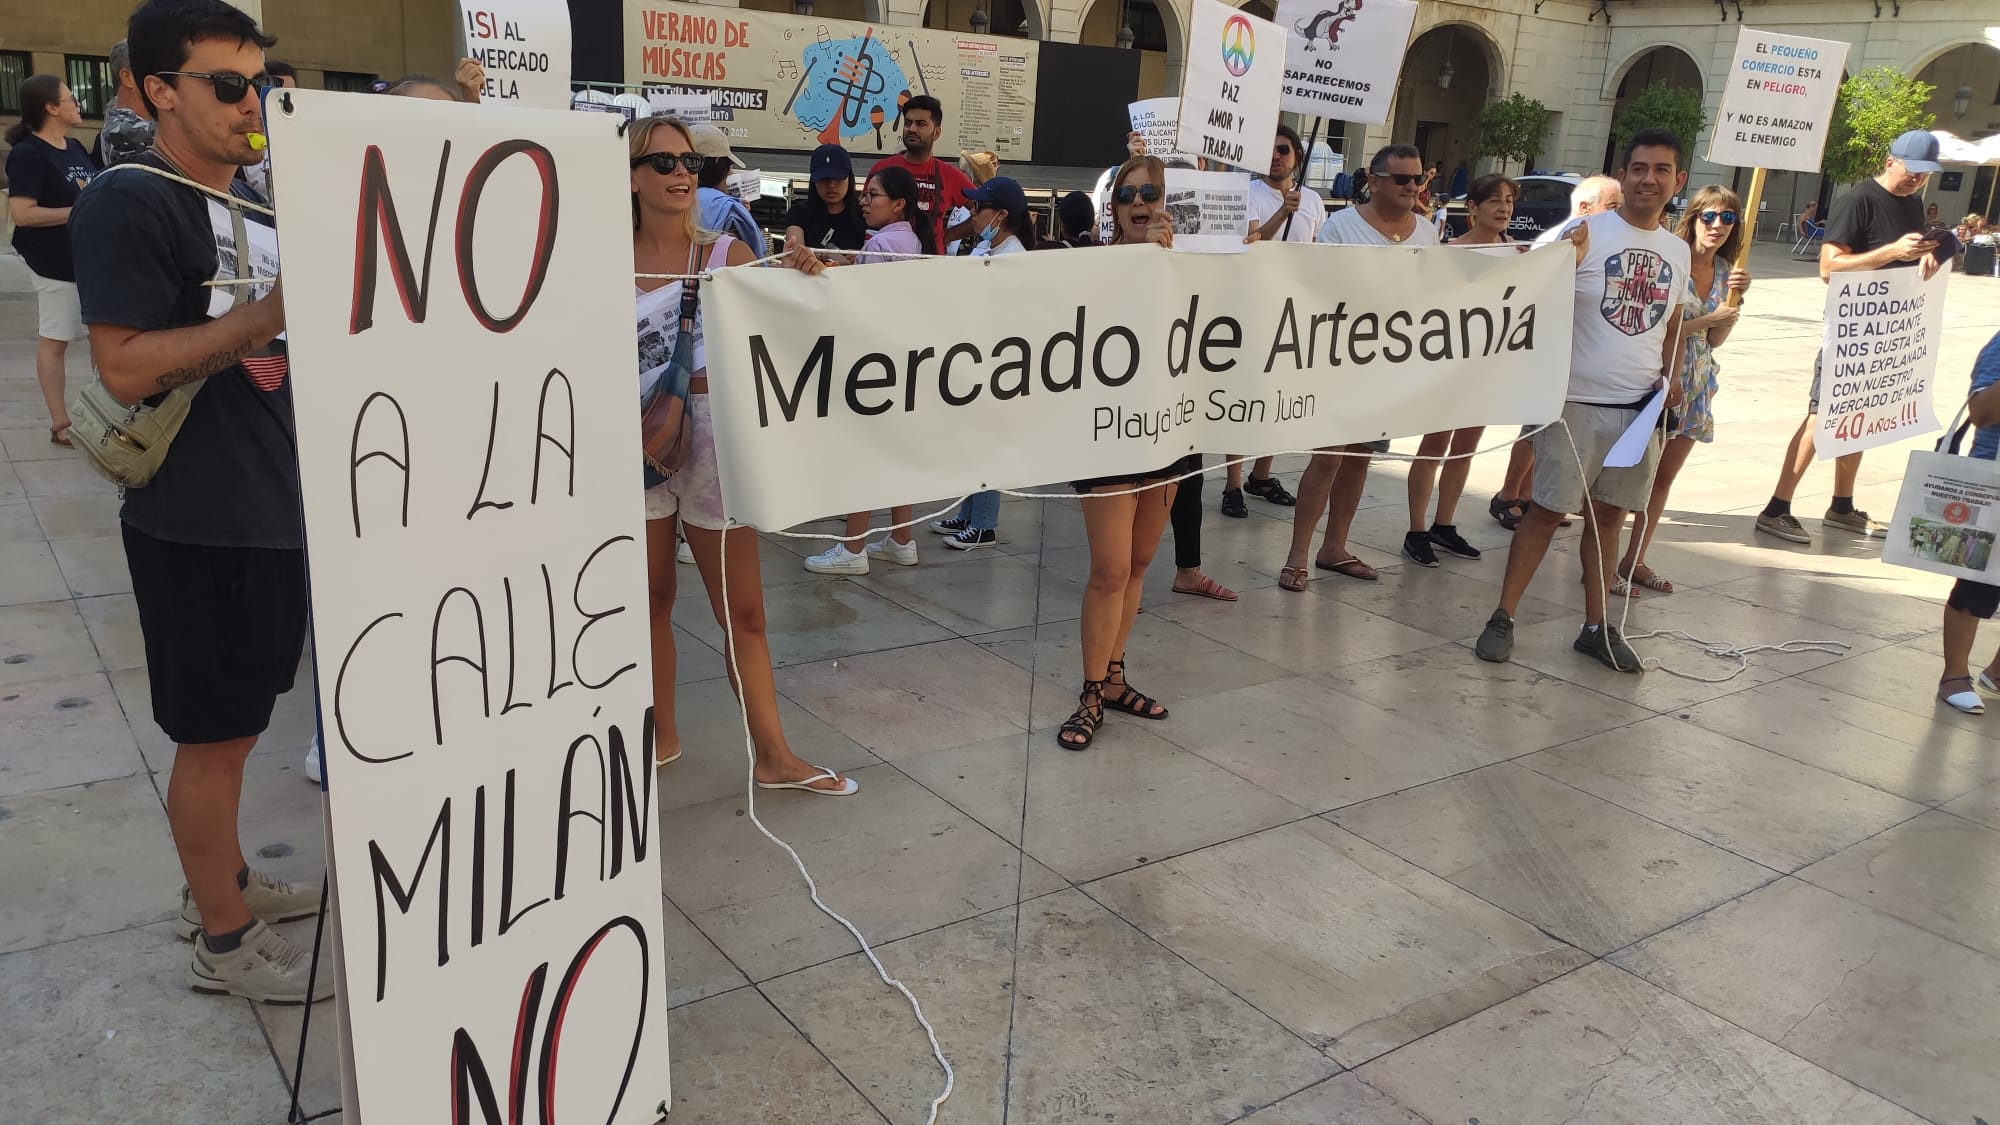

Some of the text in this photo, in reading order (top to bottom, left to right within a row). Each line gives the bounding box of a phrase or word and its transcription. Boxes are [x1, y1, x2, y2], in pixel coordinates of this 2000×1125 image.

[467, 10, 526, 41] !SI AL
[642, 10, 749, 48] VERANO DE
[472, 48, 549, 72] MERCADO
[642, 42, 726, 80] MÚSICAS
[1315, 58, 1333, 70] NO
[1756, 43, 1818, 60] EL PEQUEÑO
[1284, 69, 1371, 92] SAPARECEMOS
[1742, 60, 1822, 80] COMERCIO ESTA
[500, 79, 519, 99] LA
[1221, 81, 1240, 103] PAZ
[1296, 88, 1363, 107] EXTINGUEN
[1747, 79, 1808, 98] EN PELIGRO,
[731, 127, 748, 137] 2022
[1134, 120, 1178, 129] CIUDADANO
[1208, 108, 1245, 134] AMOR Y
[1726, 112, 1813, 132] Y NO ES AMAZON
[1203, 135, 1243, 163] TRABAJO
[1735, 131, 1797, 147] EL ENEMIGO
[349, 140, 559, 334] NO
[1508, 223, 1545, 231] CIONAL
[1627, 252, 1656, 278] PEPE
[1617, 277, 1656, 305] JEANS
[1839, 280, 1890, 298] A LOS
[1838, 293, 1926, 318] CIUDADANOS
[1838, 312, 1923, 338] DE ALICANTE
[749, 286, 1536, 427] Mercado de Artesanía
[1836, 342, 1869, 358] NOS
[1874, 335, 1911, 355] GUSTA
[1834, 344, 1927, 378] UNA EXPLANADA
[1832, 368, 1914, 398] CON NUESTRO
[1828, 378, 1925, 417] MERCADO DE MÁS
[1094, 390, 1315, 444] Playa de San Juan
[1824, 417, 1837, 430] DE
[1835, 412, 1865, 442] 40
[1866, 416, 1897, 437] AÑOS
[351, 367, 575, 538] A LA
[335, 536, 636, 763] CALLE
[368, 706, 655, 1002] MILÁN
[451, 916, 648, 1125] NO
